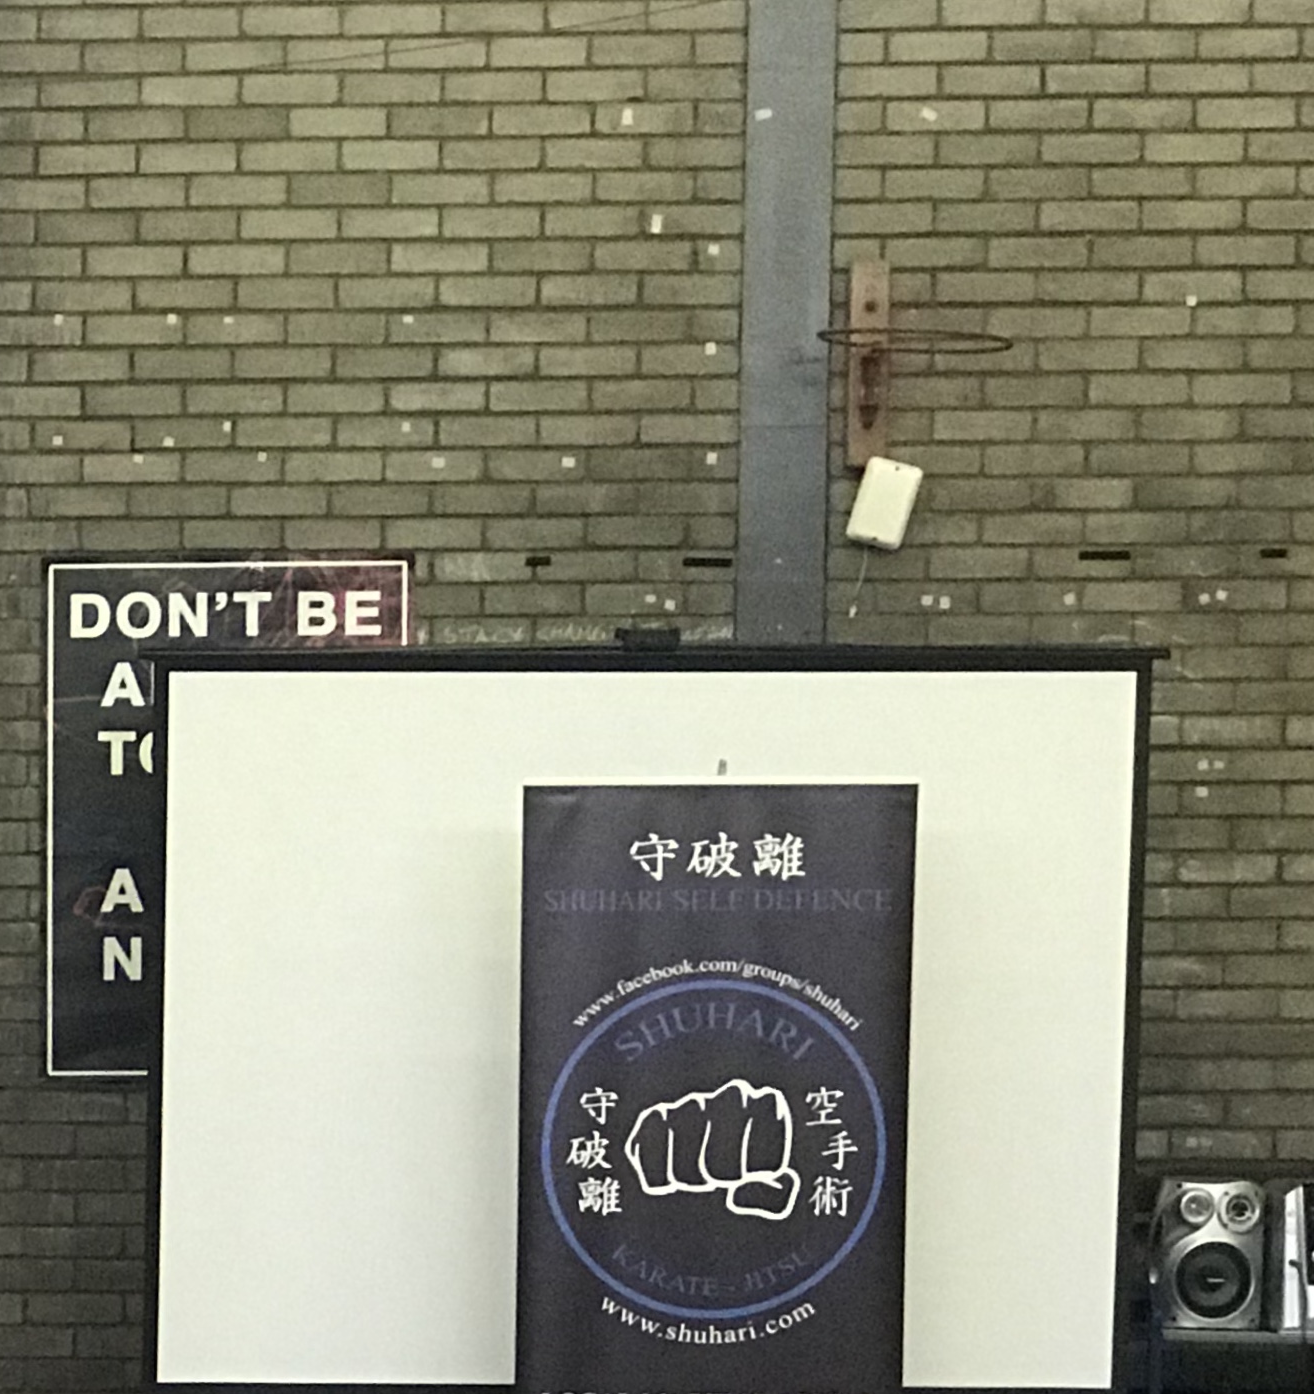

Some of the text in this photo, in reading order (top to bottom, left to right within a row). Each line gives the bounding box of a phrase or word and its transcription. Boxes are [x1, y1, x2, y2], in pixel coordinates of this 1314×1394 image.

[297, 591, 381, 636] BE
[629, 831, 806, 882] 守破離
[544, 888, 662, 912] SHUHARI
[573, 957, 863, 1031] www.facebook.com/groups/shuhari
[615, 1003, 815, 1061] SHUHARI
[567, 1087, 622, 1216] 守破離
[601, 1297, 815, 1344] www.shuhari.com
